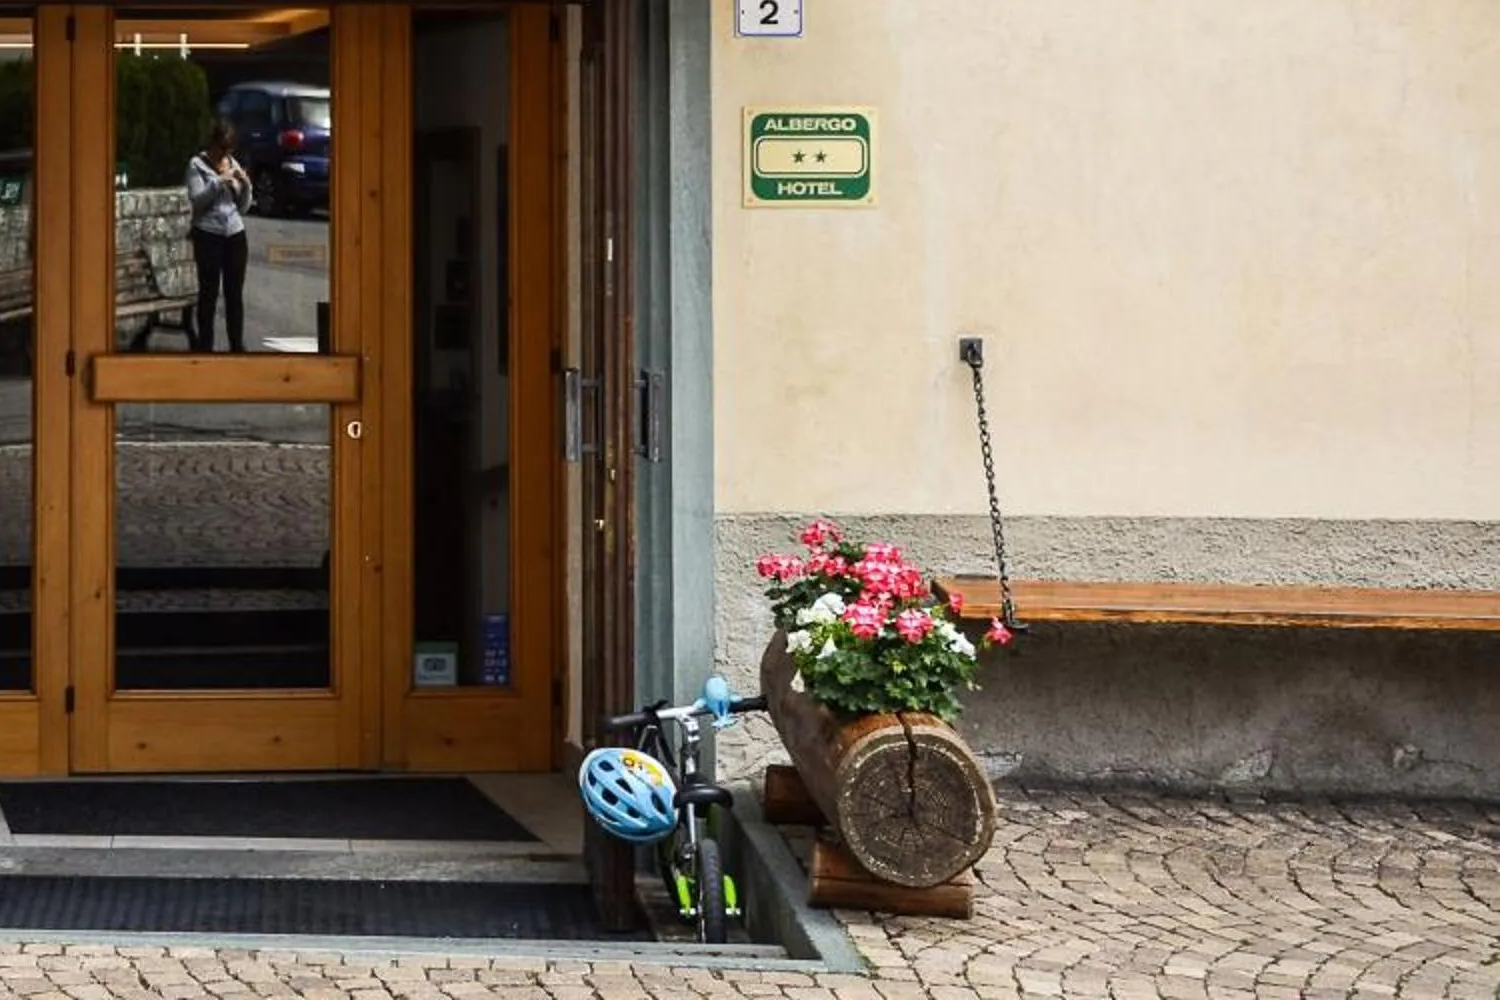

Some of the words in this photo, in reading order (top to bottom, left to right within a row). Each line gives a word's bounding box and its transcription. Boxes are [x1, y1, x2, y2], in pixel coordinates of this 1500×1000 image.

[759, 0, 779, 25] 2
[764, 117, 857, 131] ALBERGO
[777, 181, 843, 195] HOTEL
